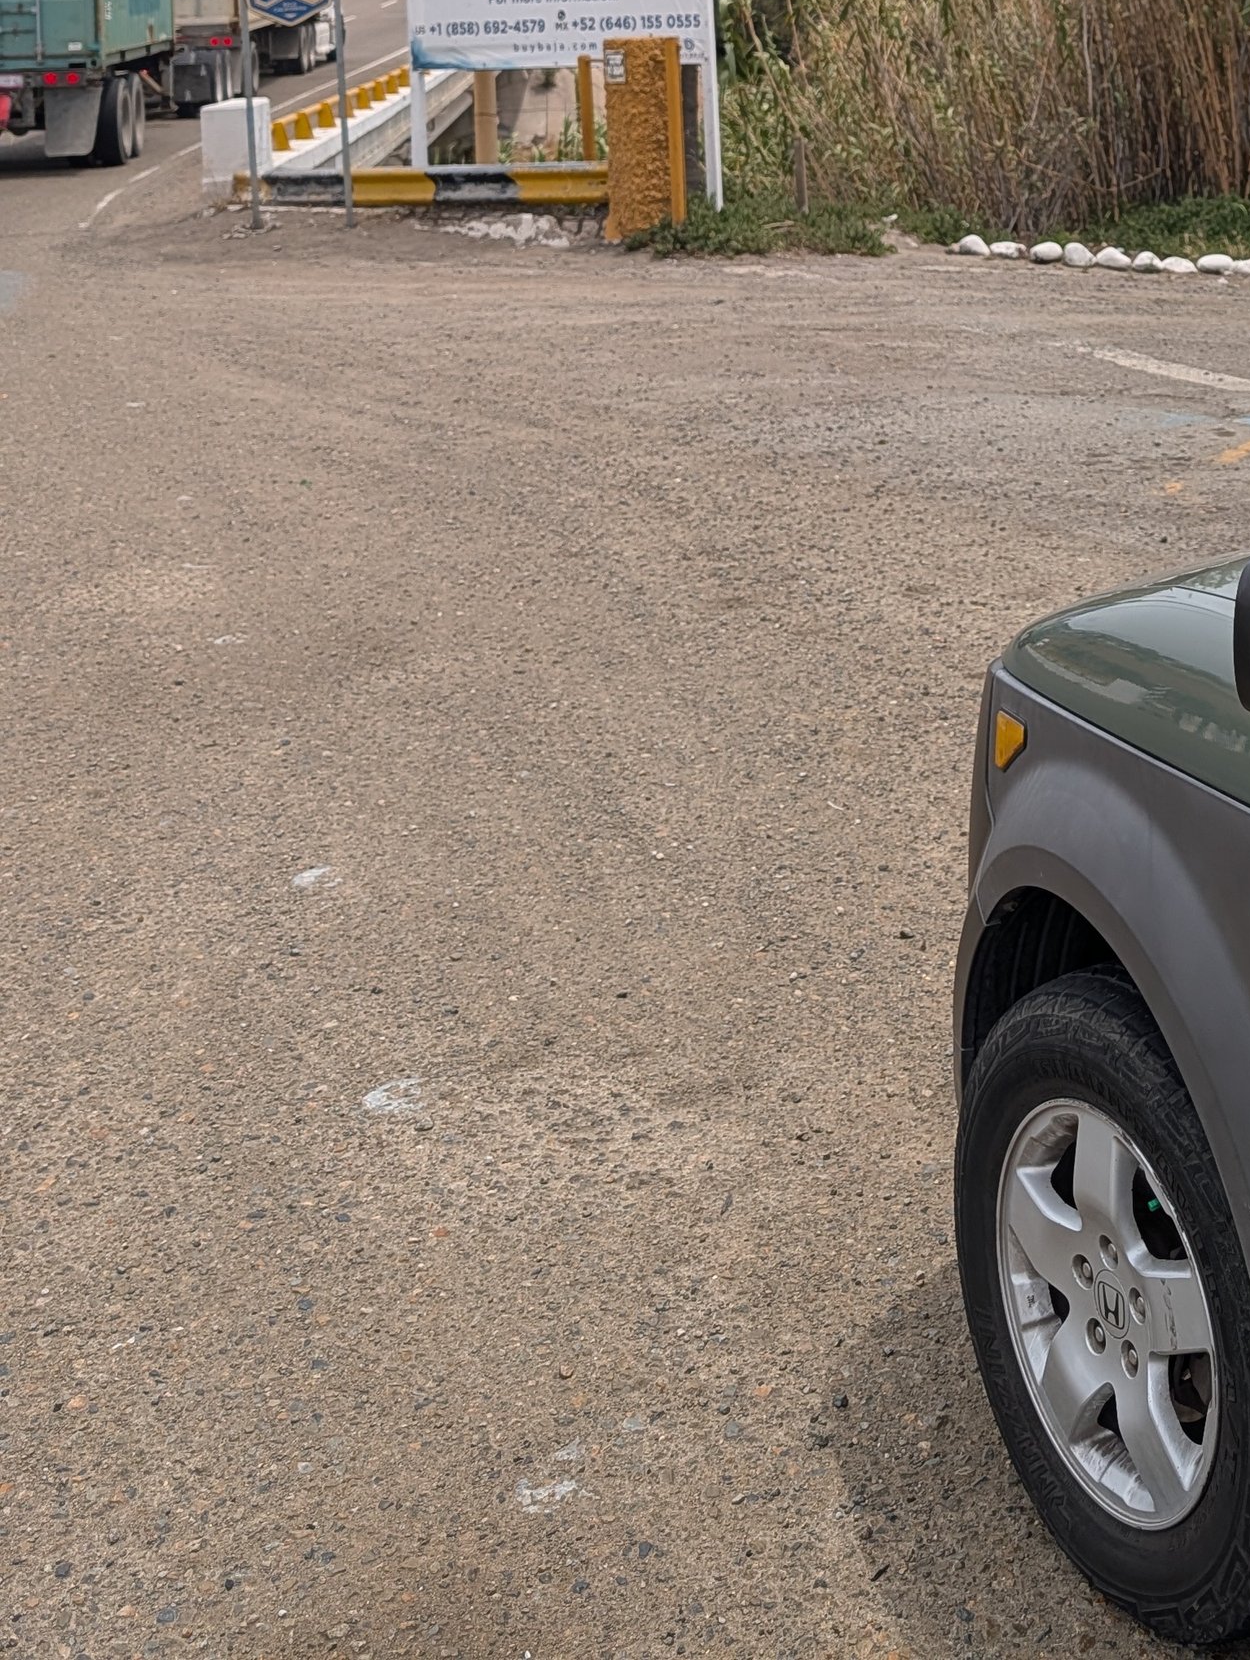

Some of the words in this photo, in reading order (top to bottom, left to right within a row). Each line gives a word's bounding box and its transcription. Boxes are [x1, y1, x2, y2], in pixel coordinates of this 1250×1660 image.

[429, 22, 442, 36] +1
[571, 17, 596, 32] +52
[600, 15, 637, 32] (646)
[640, 14, 663, 29] 155
[666, 13, 701, 29] 0555
